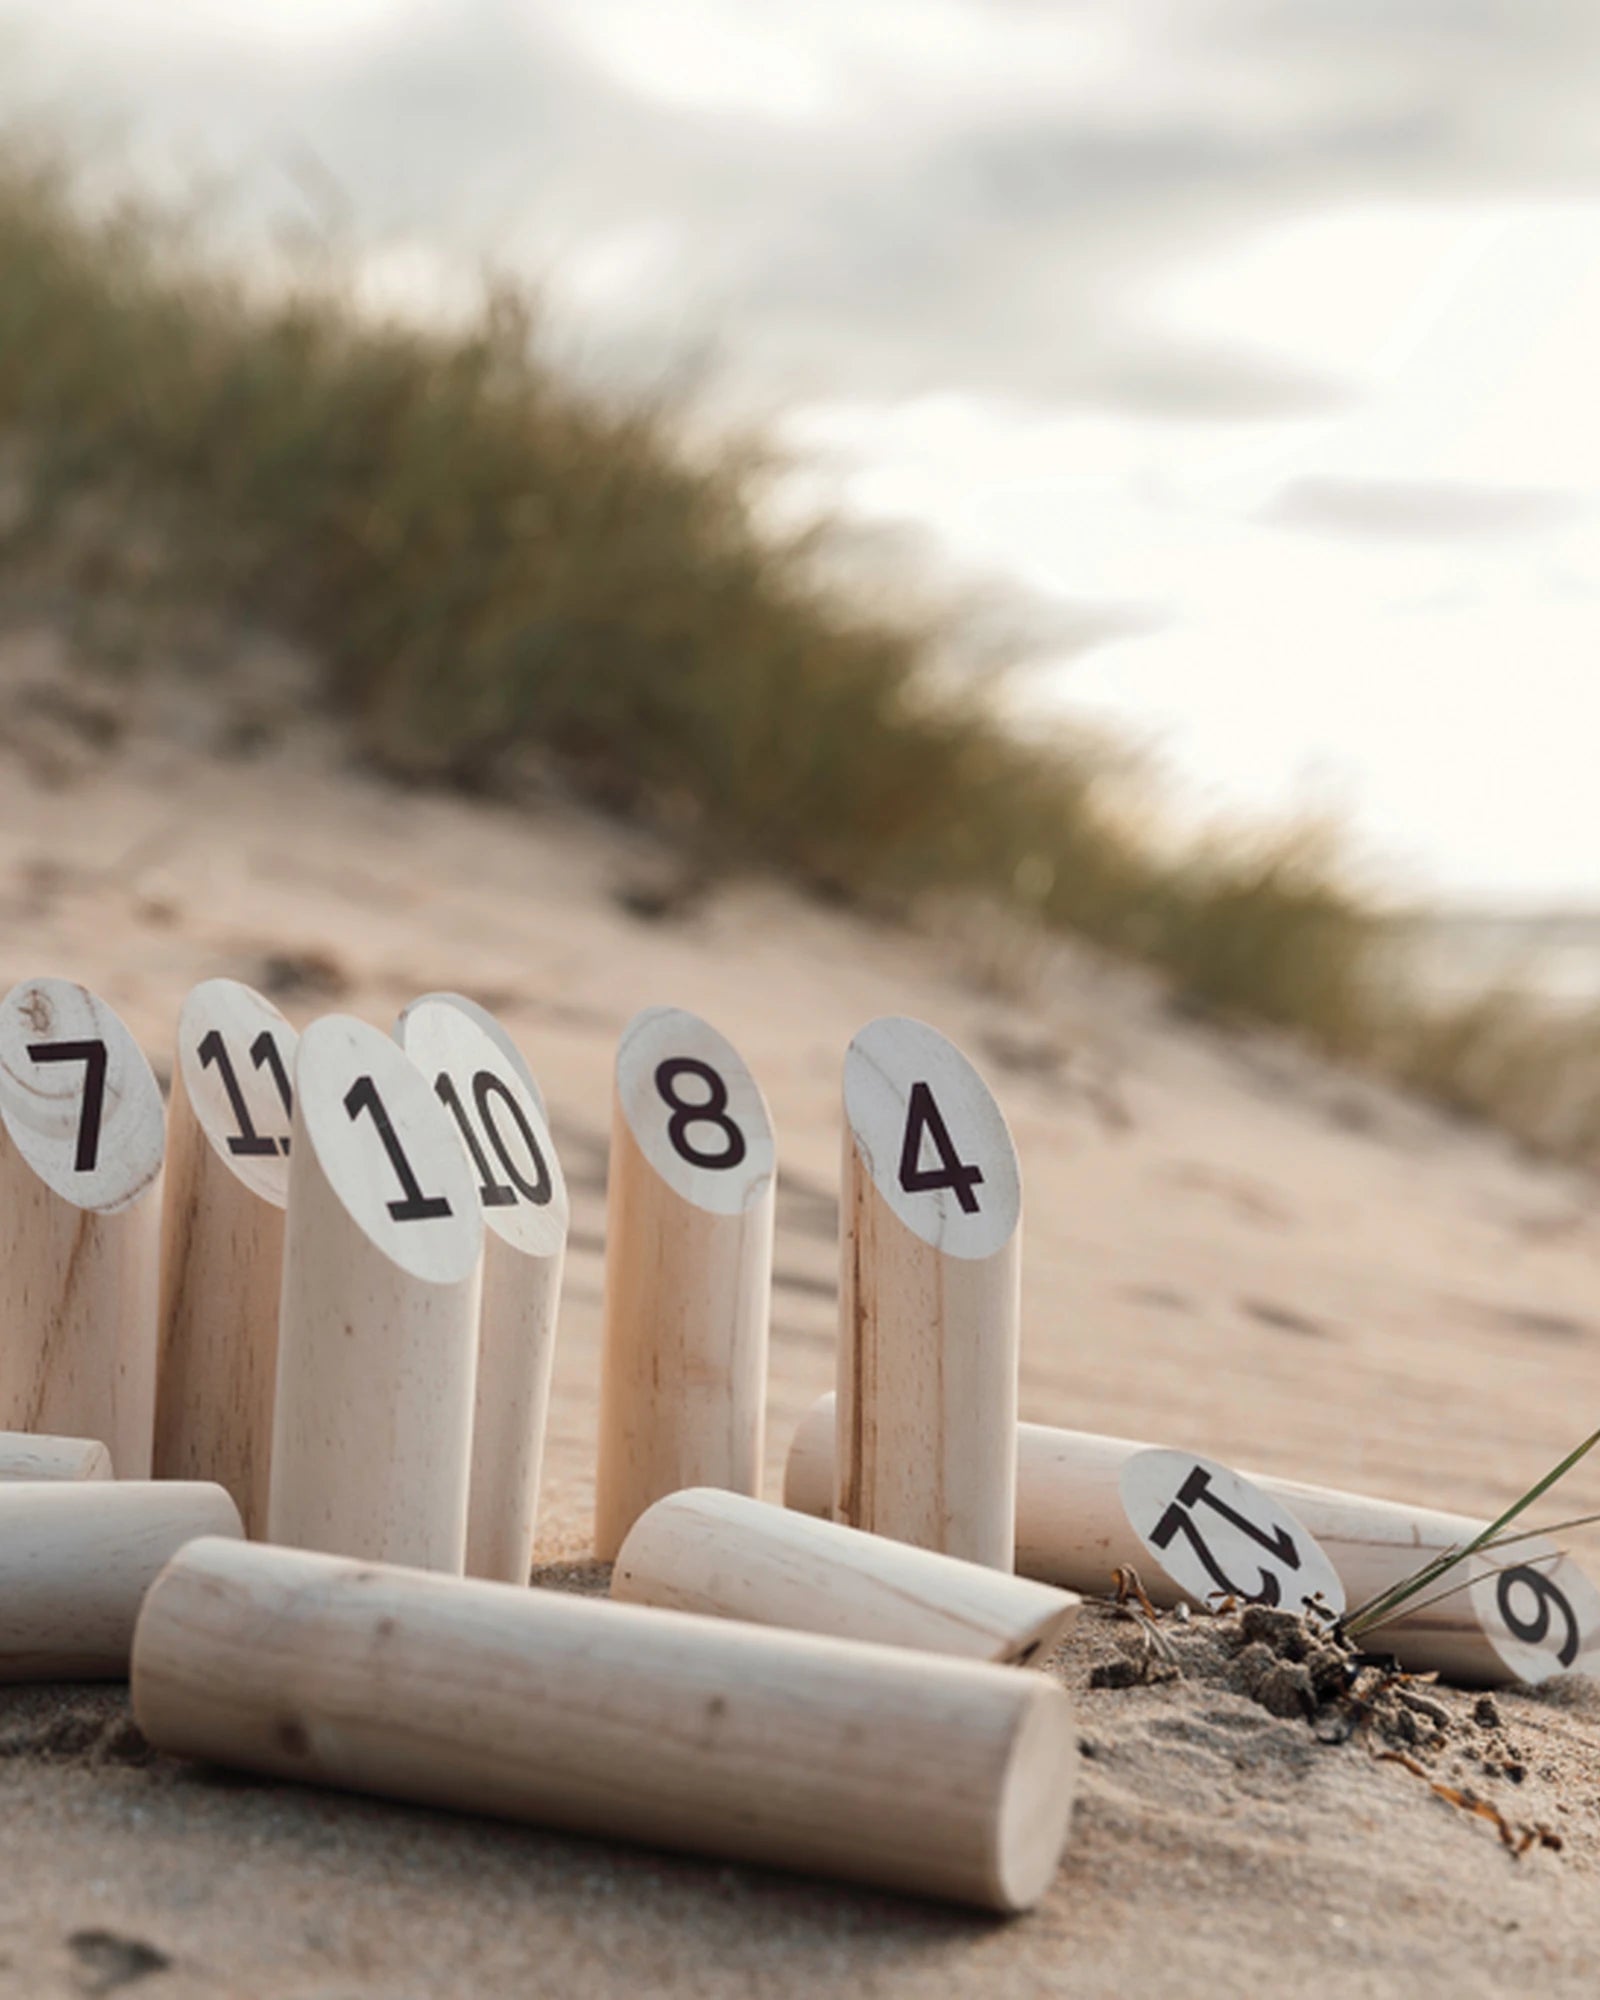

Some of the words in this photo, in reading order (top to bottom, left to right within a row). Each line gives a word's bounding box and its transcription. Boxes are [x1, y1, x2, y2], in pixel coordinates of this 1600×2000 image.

[26, 1039, 108, 1172] 7
[343, 1075, 454, 1222] 1
[434, 1070, 552, 1207] 10
[654, 1056, 747, 1171] 8
[898, 1081, 985, 1214] 4
[1149, 1464, 1301, 1607] 12
